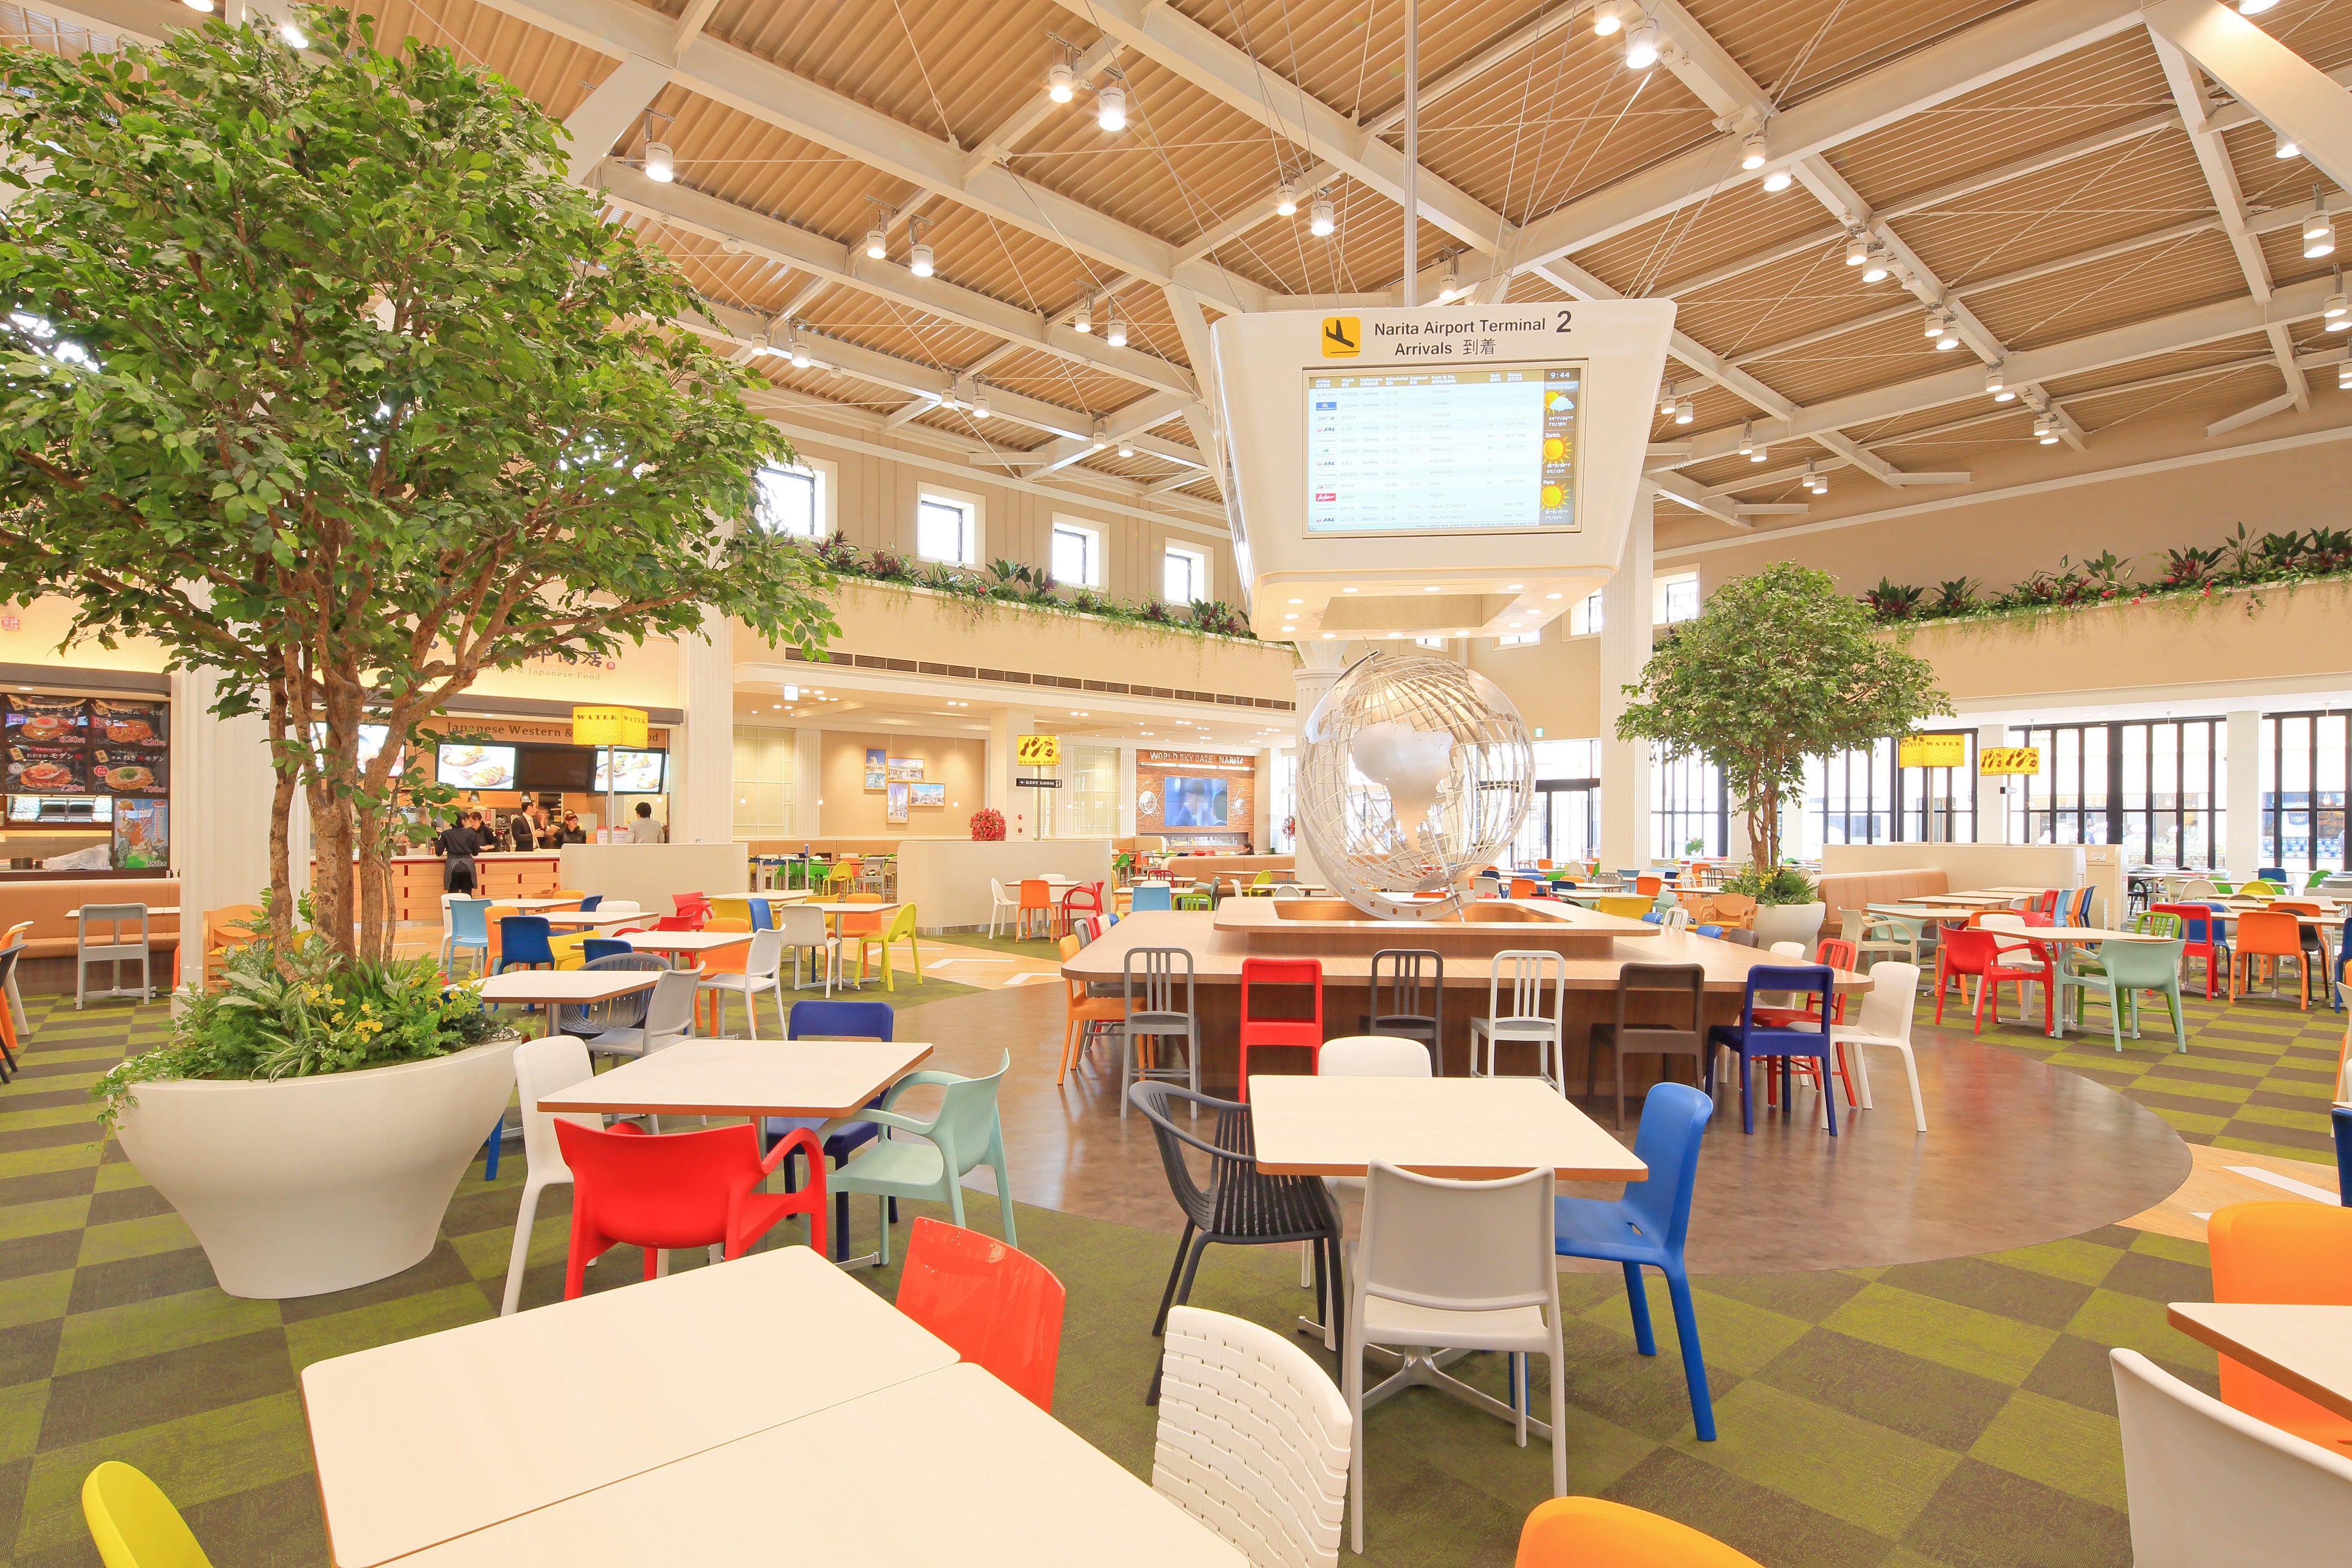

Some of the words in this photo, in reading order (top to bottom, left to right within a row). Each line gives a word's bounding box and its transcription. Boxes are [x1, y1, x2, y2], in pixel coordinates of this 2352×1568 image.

[1374, 323, 1419, 336] Narita
[1423, 321, 1475, 337] Airport
[1479, 317, 1546, 332] Terminal
[1556, 310, 1572, 333] 2
[1394, 341, 1453, 356] Arrivals
[1462, 337, 1497, 355] 到着
[528, 667, 572, 678] Japanese
[577, 671, 601, 681] Food
[624, 715, 646, 724] WATER
[509, 726, 561, 737] Western
[564, 729, 573, 737] &
[1149, 751, 1178, 760] WORLD
[1180, 753, 1193, 762] SKY
[1195, 754, 1213, 763] GATE
[1219, 756, 1245, 765] NARITA
